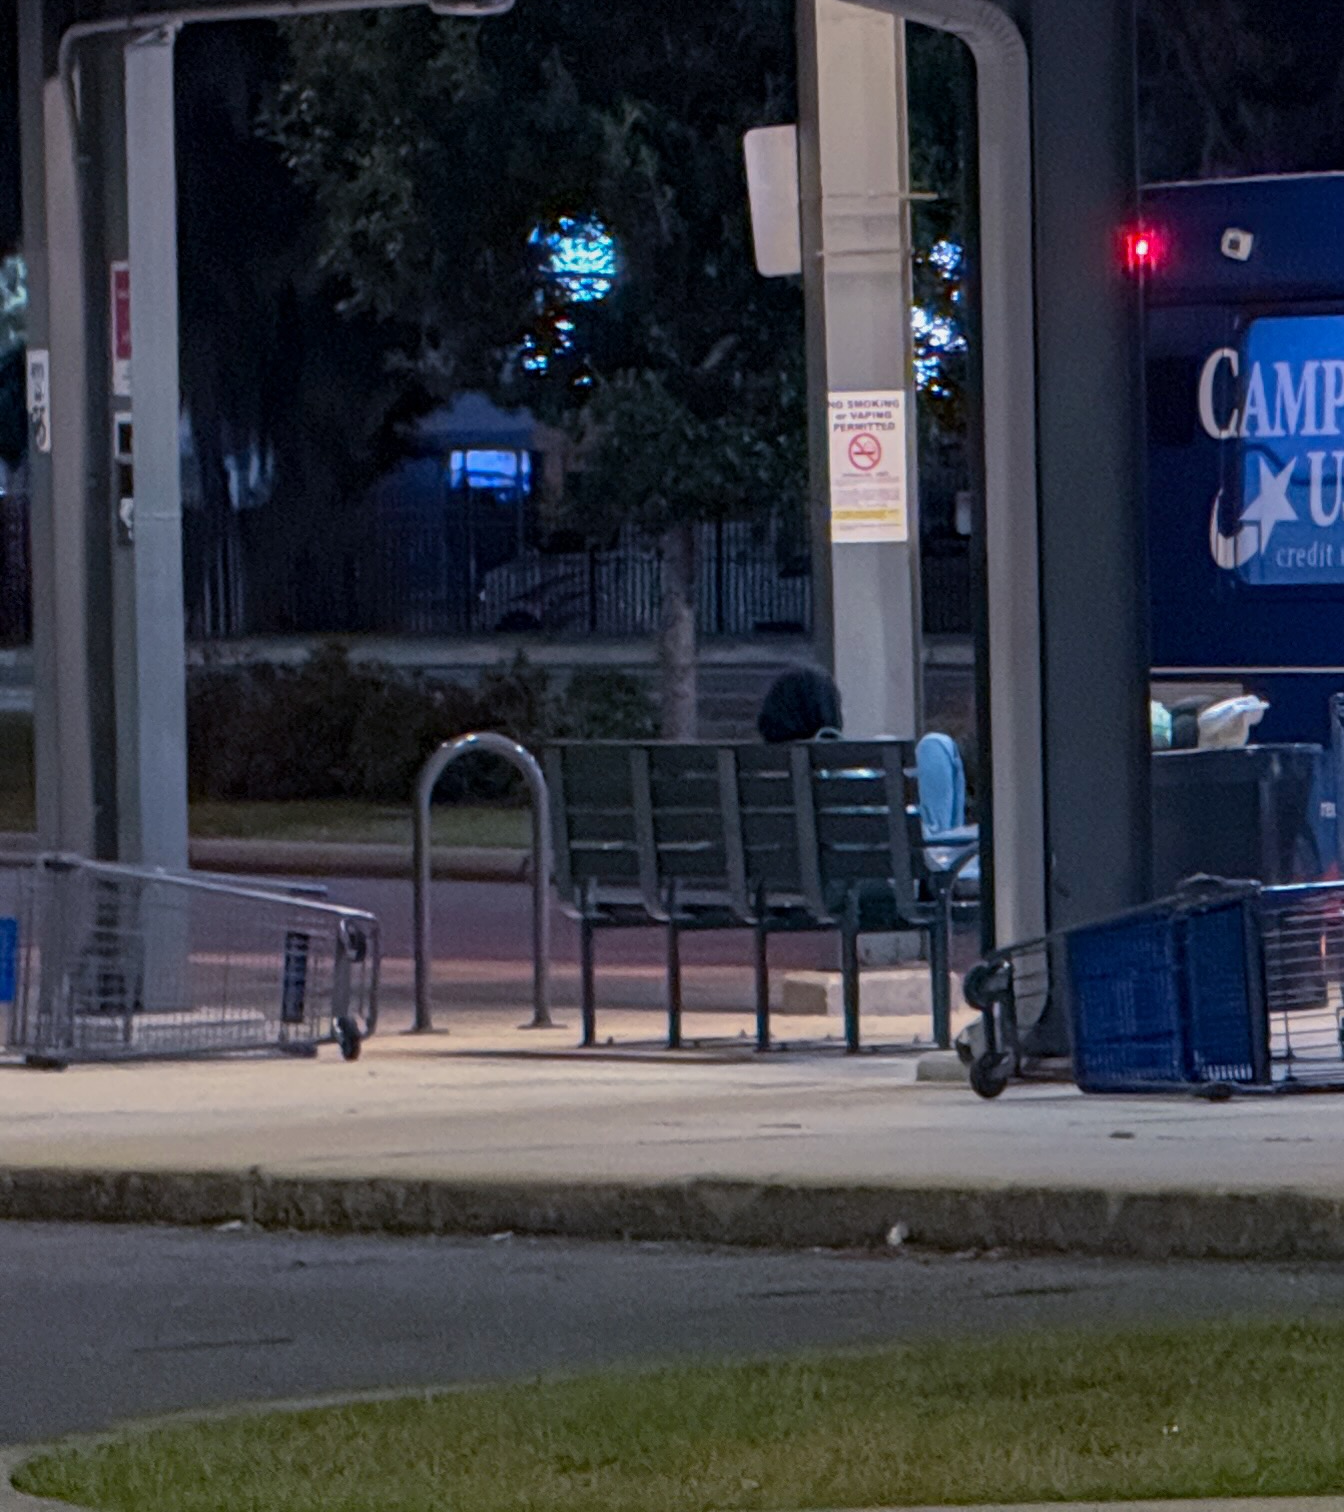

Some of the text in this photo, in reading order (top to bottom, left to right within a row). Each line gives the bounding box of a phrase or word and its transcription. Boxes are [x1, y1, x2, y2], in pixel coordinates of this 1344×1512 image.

[847, 399, 900, 409] SMOKING
[850, 411, 892, 420] VAPING
[833, 422, 896, 432] PERMITTED
[1275, 541, 1332, 568] credit
